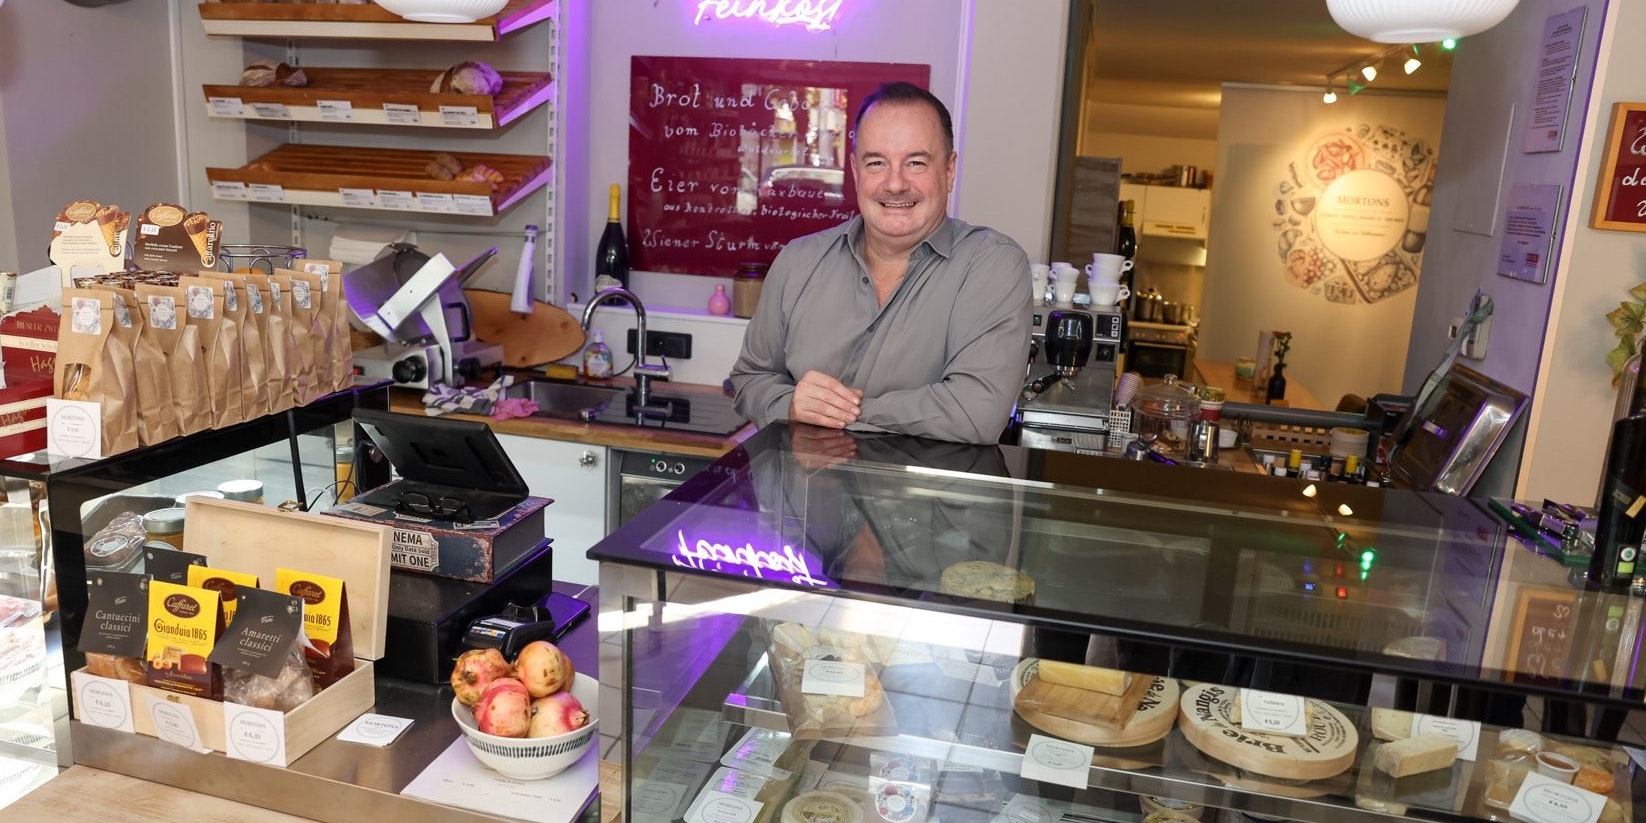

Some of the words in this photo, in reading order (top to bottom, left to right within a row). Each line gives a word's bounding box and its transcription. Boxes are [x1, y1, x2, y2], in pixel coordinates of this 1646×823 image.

[650, 83, 701, 108] Brot
[713, 94, 755, 108] und
[664, 125, 699, 138] vom
[650, 167, 700, 193] Eier
[663, 203, 680, 212] aus
[1336, 195, 1390, 208] MORTONS
[642, 228, 700, 249] Wiener
[704, 229, 760, 251] Sturm
[393, 531, 423, 546] NEMA
[391, 552, 407, 564] MIT
[409, 555, 430, 568] ONE
[166, 596, 198, 614] Caffarel
[95, 609, 141, 624] Cantuccini
[100, 620, 132, 633] classici
[191, 627, 207, 641] 1865
[241, 627, 281, 643] Amaretti
[240, 636, 273, 652] classici
[1194, 686, 1225, 722] Nangis
[1222, 729, 1289, 755] Brie
